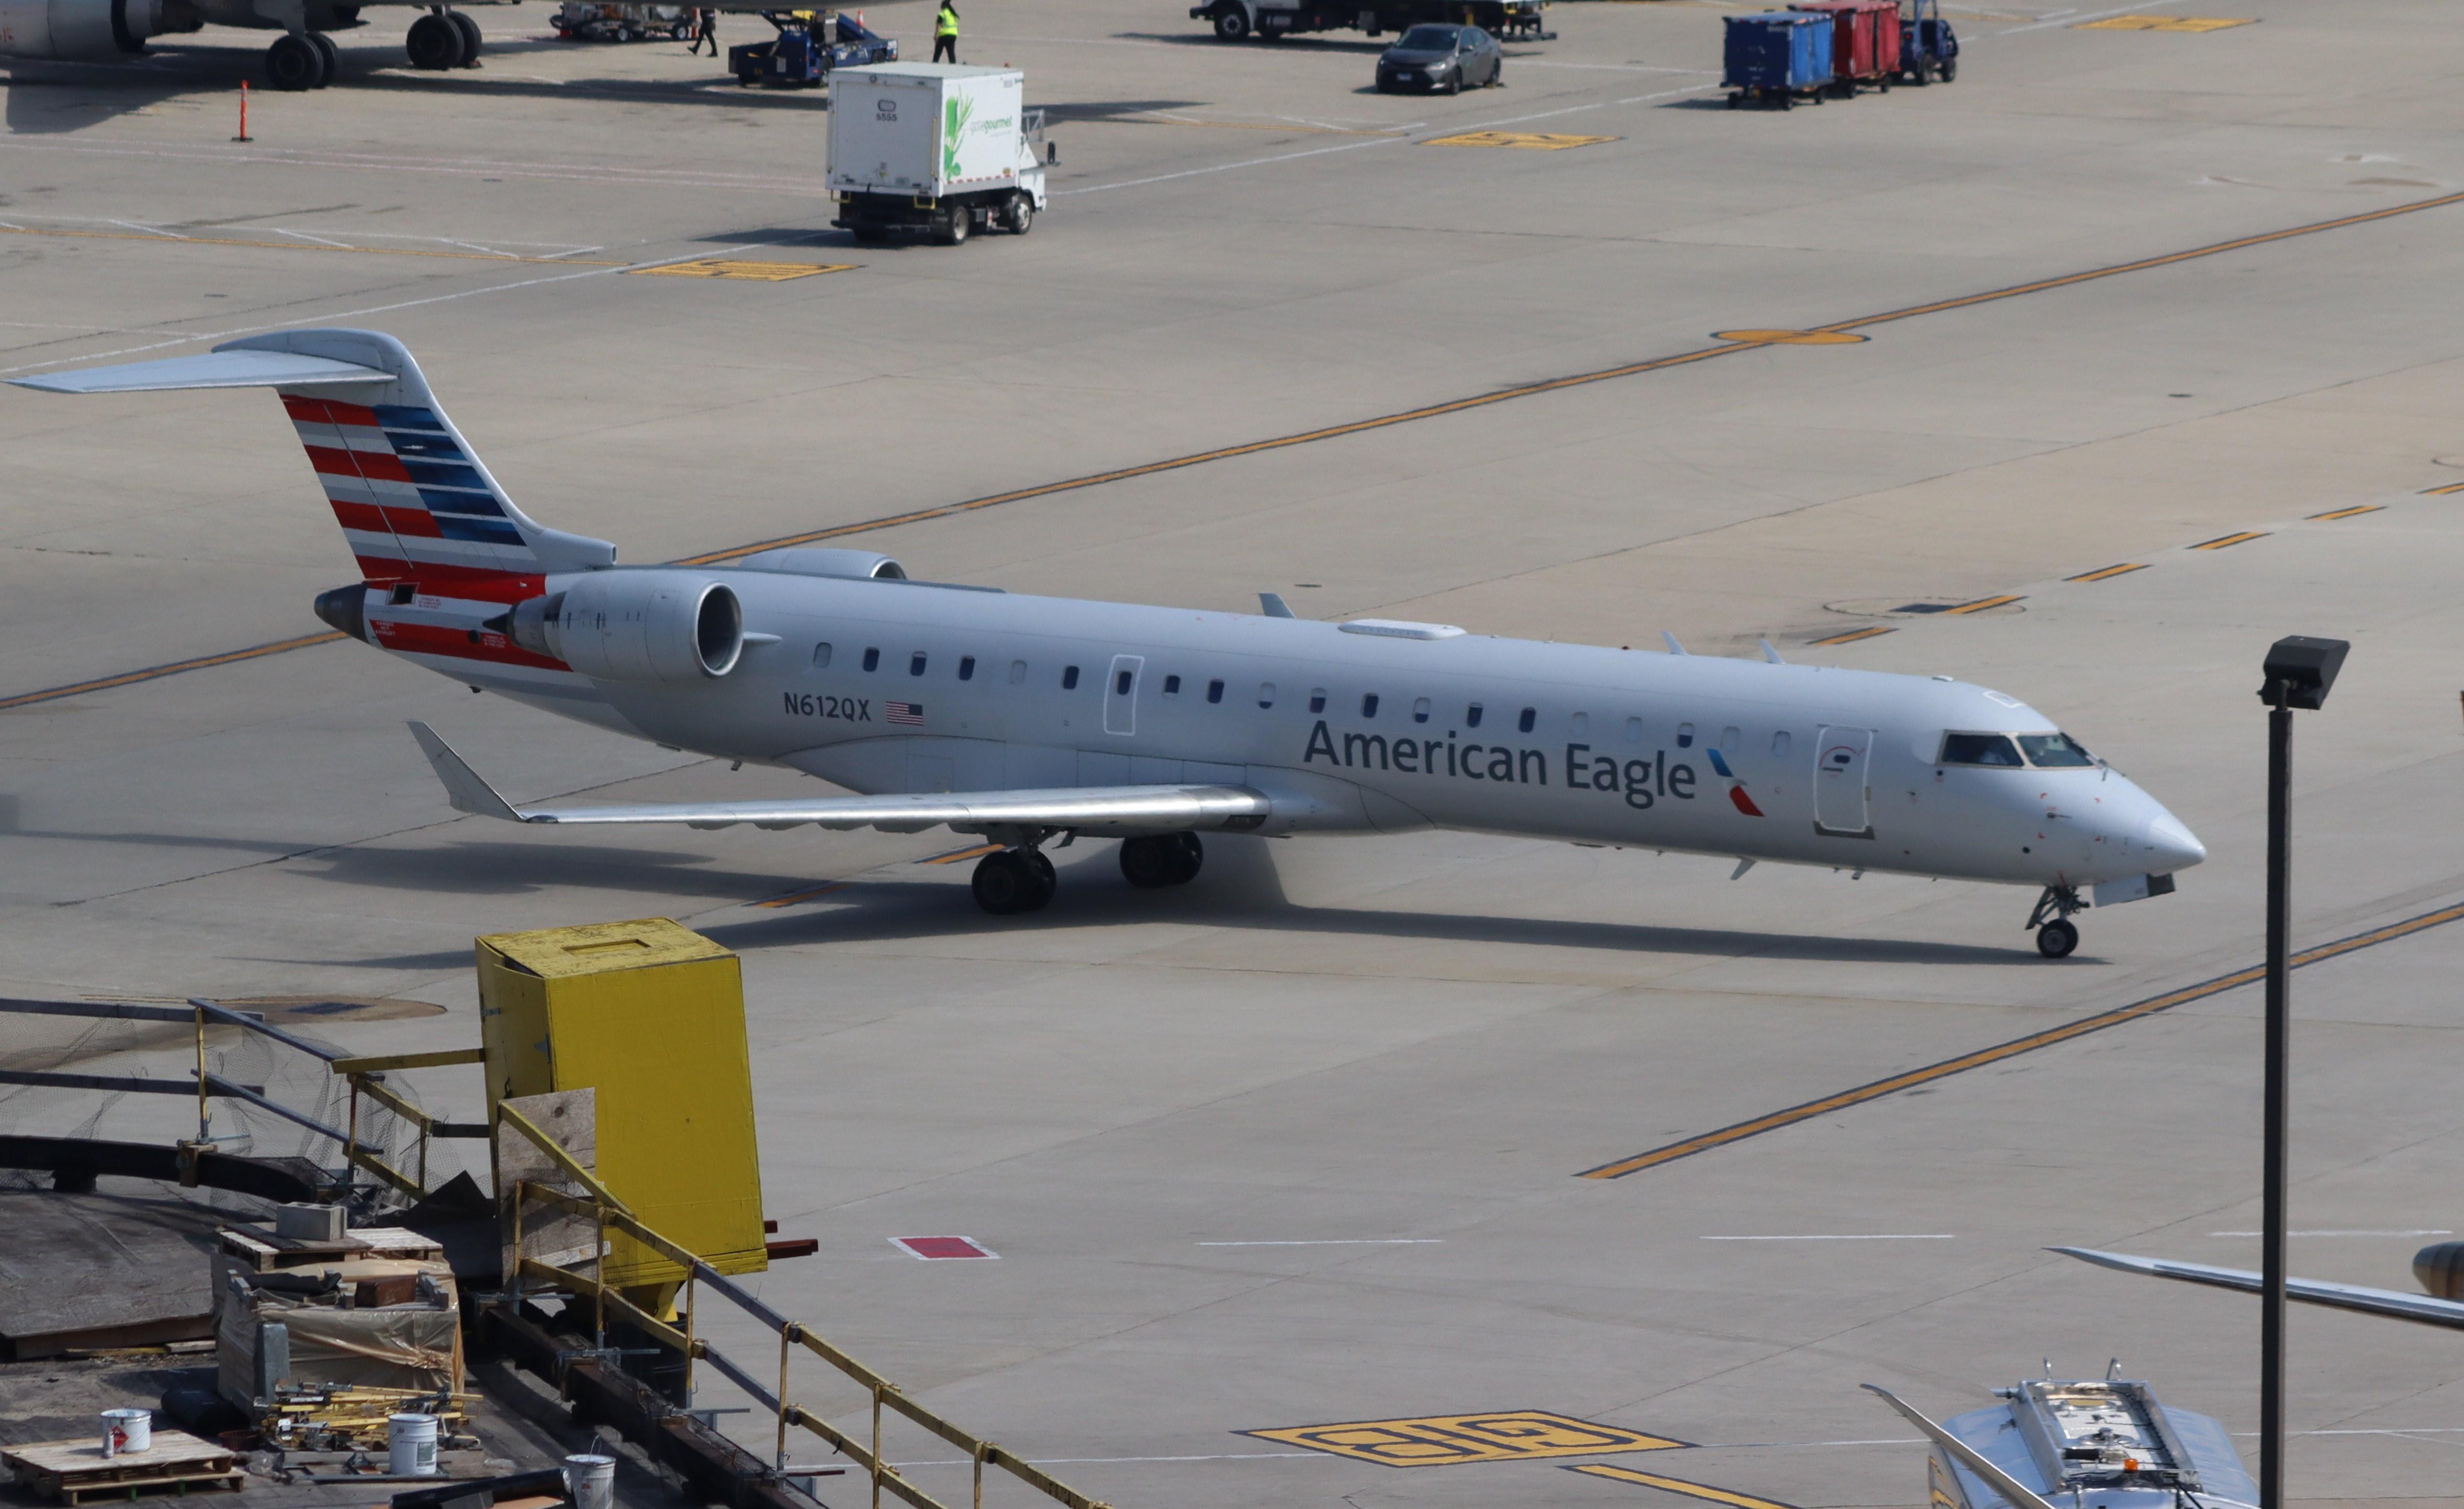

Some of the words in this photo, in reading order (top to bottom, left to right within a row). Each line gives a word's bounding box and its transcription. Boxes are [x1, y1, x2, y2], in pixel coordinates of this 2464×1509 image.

[784, 692, 872, 722] N612QX
[1303, 720, 1547, 785] American
[1566, 743, 1696, 809] Eagle
